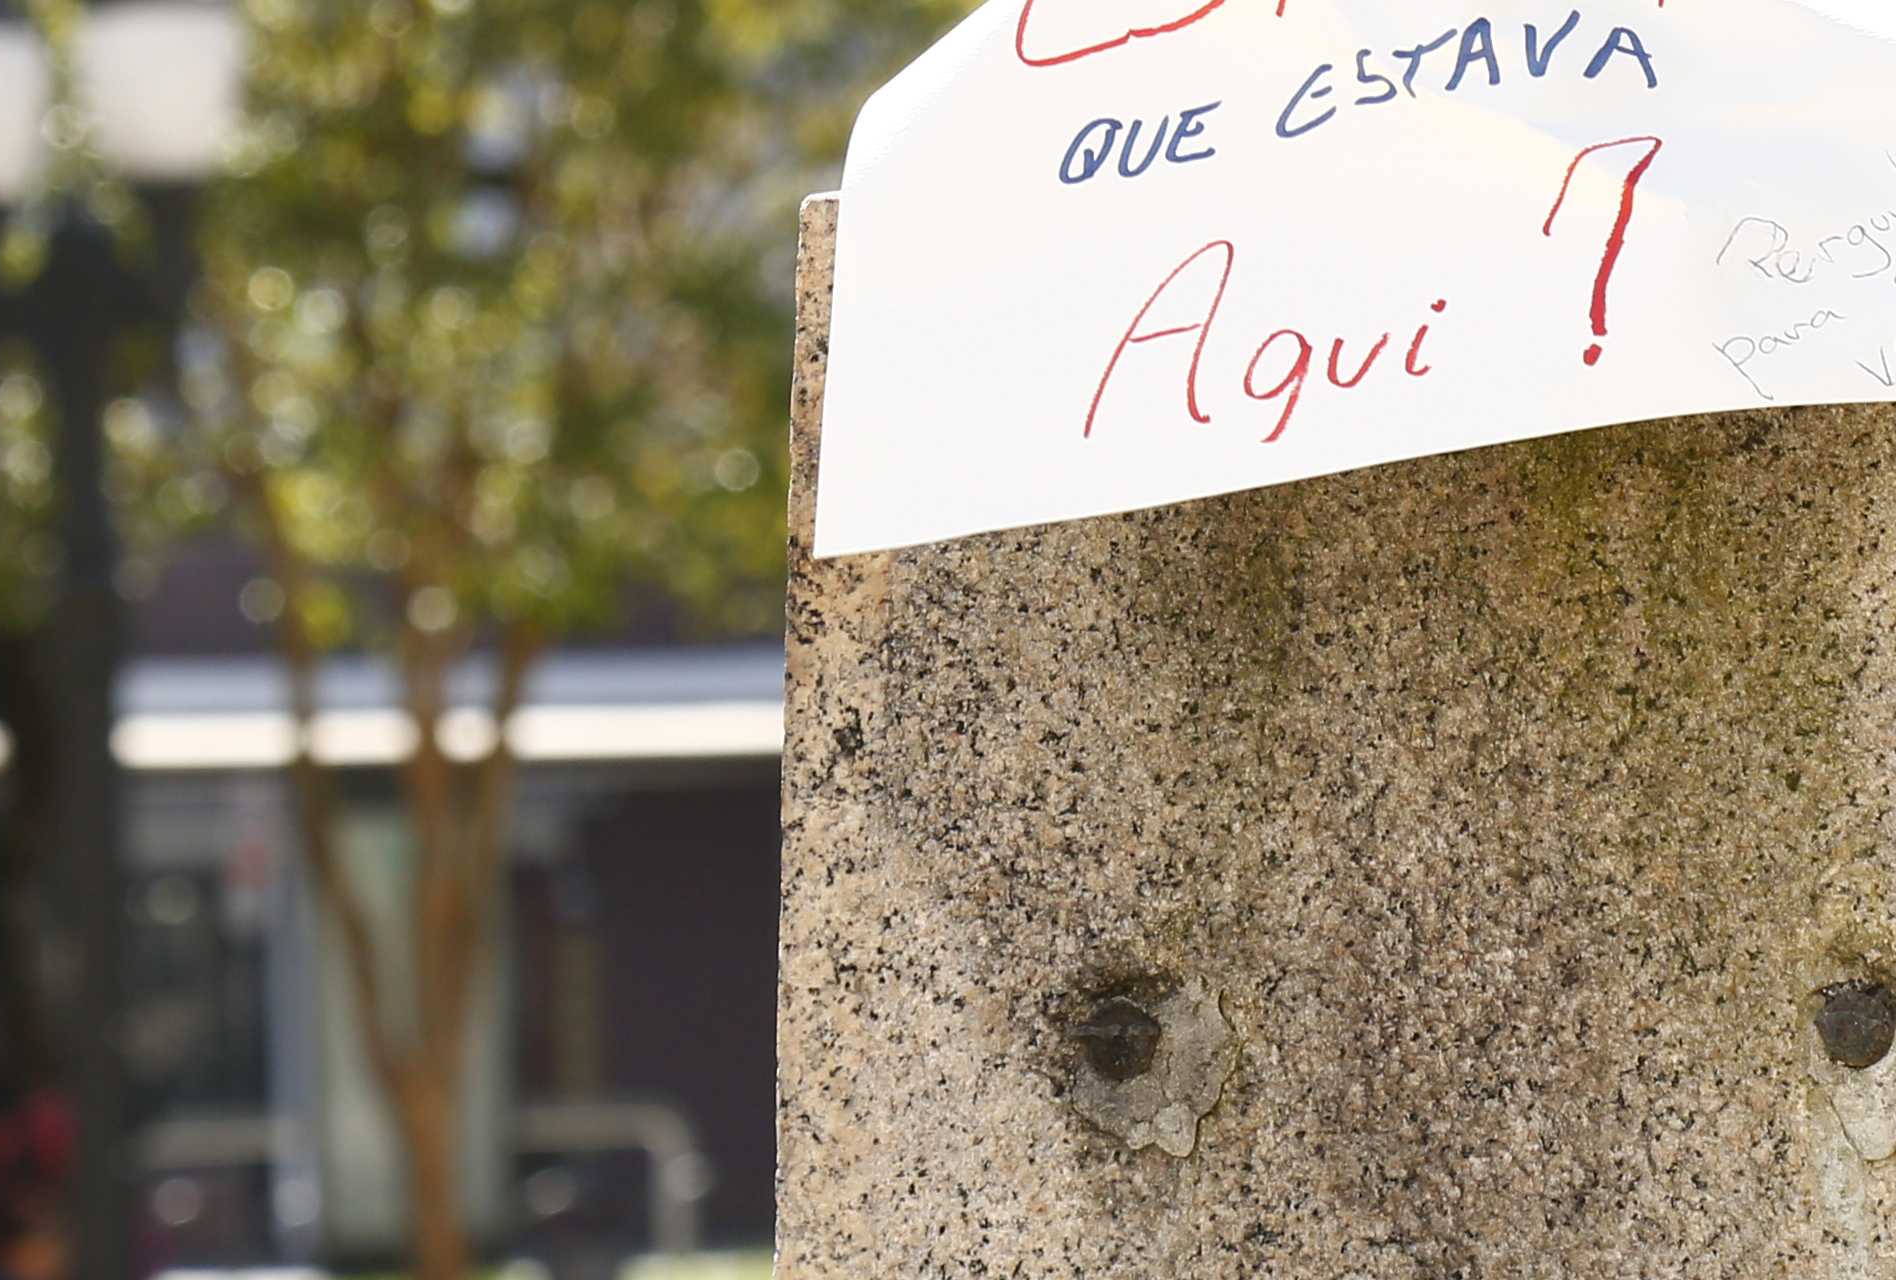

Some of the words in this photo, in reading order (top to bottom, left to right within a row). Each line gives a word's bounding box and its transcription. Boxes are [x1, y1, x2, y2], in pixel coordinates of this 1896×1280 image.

[1060, 102, 1222, 184] QUE
[1276, 8, 1659, 138] ESTAVA
[1084, 240, 1447, 442] Aqui
[1542, 134, 1664, 367] ?
[1711, 308, 1847, 401] para
